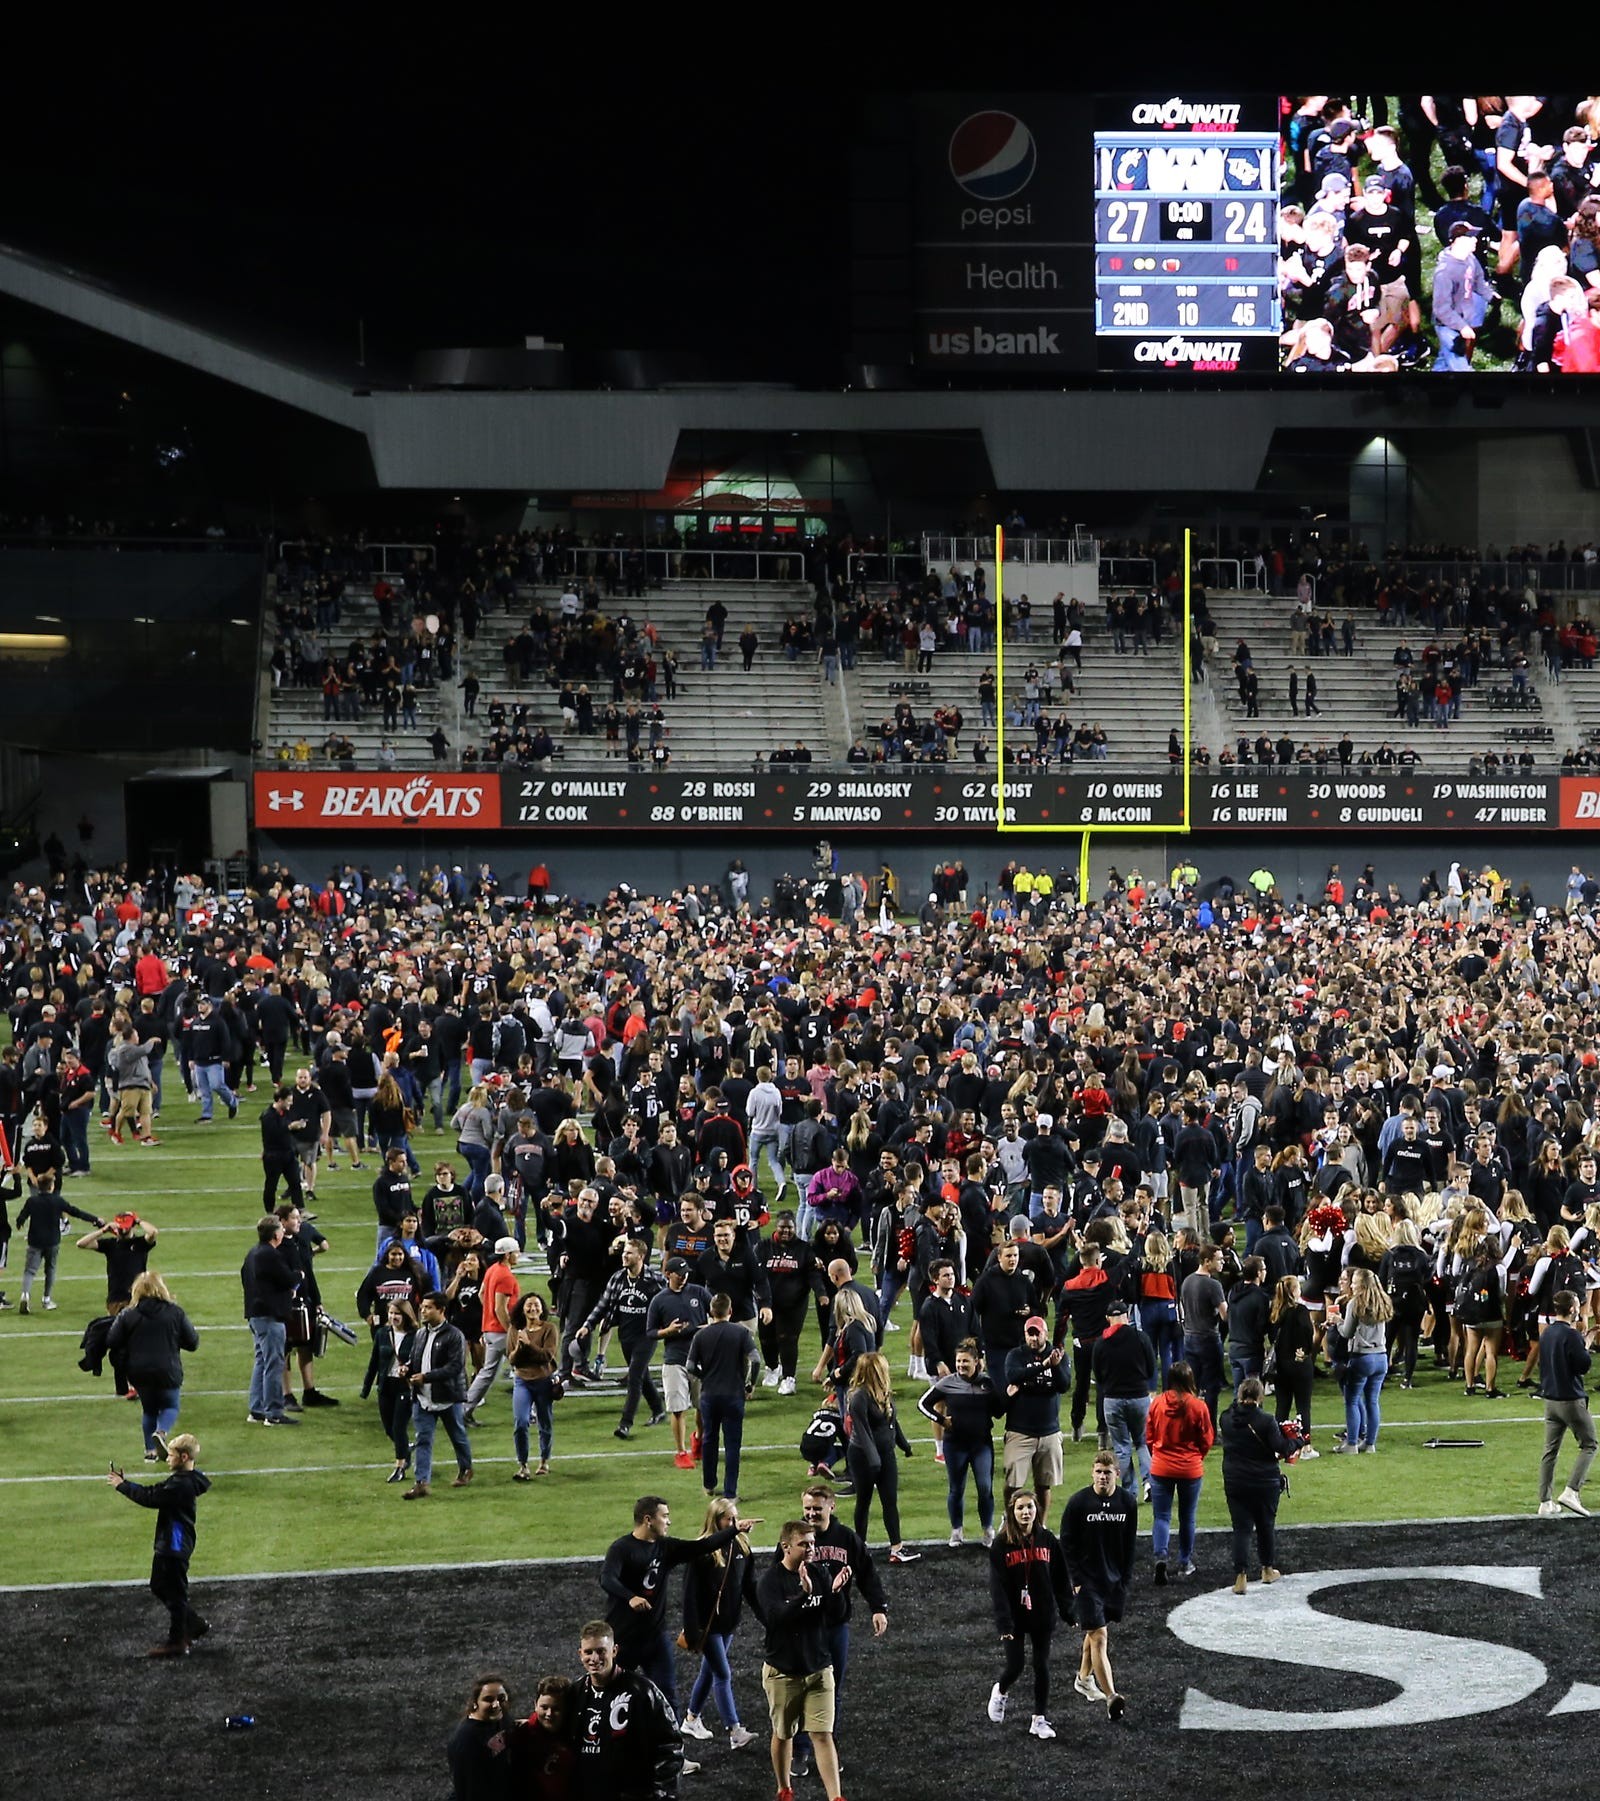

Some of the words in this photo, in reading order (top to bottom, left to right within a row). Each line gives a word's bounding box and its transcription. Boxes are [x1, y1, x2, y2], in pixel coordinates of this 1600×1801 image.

[1132, 97, 1241, 125] CINCINNATI
[961, 204, 1032, 230] pepsi
[1107, 201, 1148, 242] 27
[1168, 201, 1203, 223] 0:00
[1224, 201, 1266, 242] 24
[966, 263, 1059, 289] Health
[1113, 303, 1149, 326] 2ND
[1177, 303, 1199, 326] 10
[1232, 303, 1256, 326] 45
[1134, 335, 1241, 362] CINCINNATI
[1193, 360, 1237, 371] BEARCATS
[520, 781, 545, 797] 27
[551, 781, 627, 797] O'MALLEY
[681, 782, 706, 797] 28
[713, 782, 755, 797] ROSSI
[807, 782, 832, 798] 29
[838, 782, 912, 798] SHALOSKY
[962, 783, 986, 798] 62
[1087, 783, 1107, 798] 10
[1113, 783, 1163, 798] OWENS
[1210, 783, 1230, 798] 16
[1236, 783, 1259, 798] LEE
[1307, 783, 1331, 799] 30
[1335, 784, 1386, 799] WOODS
[1432, 784, 1452, 799] 19
[1456, 784, 1547, 799] WASHINGTON
[321, 780, 483, 818] BEARCATS
[519, 806, 540, 821] 12
[545, 806, 587, 821] COOK
[650, 806, 675, 821] 88
[680, 806, 743, 821] O'BRIEN
[793, 806, 805, 822] 5
[810, 806, 881, 821] MARVASO
[934, 807, 958, 822] 30
[1080, 807, 1092, 822] 8
[1097, 807, 1152, 822] McCOIN
[1212, 807, 1231, 822] 16
[1238, 807, 1287, 822] RUFFIN
[1339, 807, 1352, 823] 8
[1357, 808, 1422, 823] GUIDUGLI
[1474, 807, 1497, 823] 47
[1501, 808, 1547, 823] HUBER
[808, 1022, 817, 1038] 5
[671, 1042, 679, 1057] 5
[646, 1099, 657, 1117] 19
[735, 1208, 750, 1226] 19
[806, 1419, 837, 1438] 19
[1087, 1511, 1127, 1522] CINCINNATI
